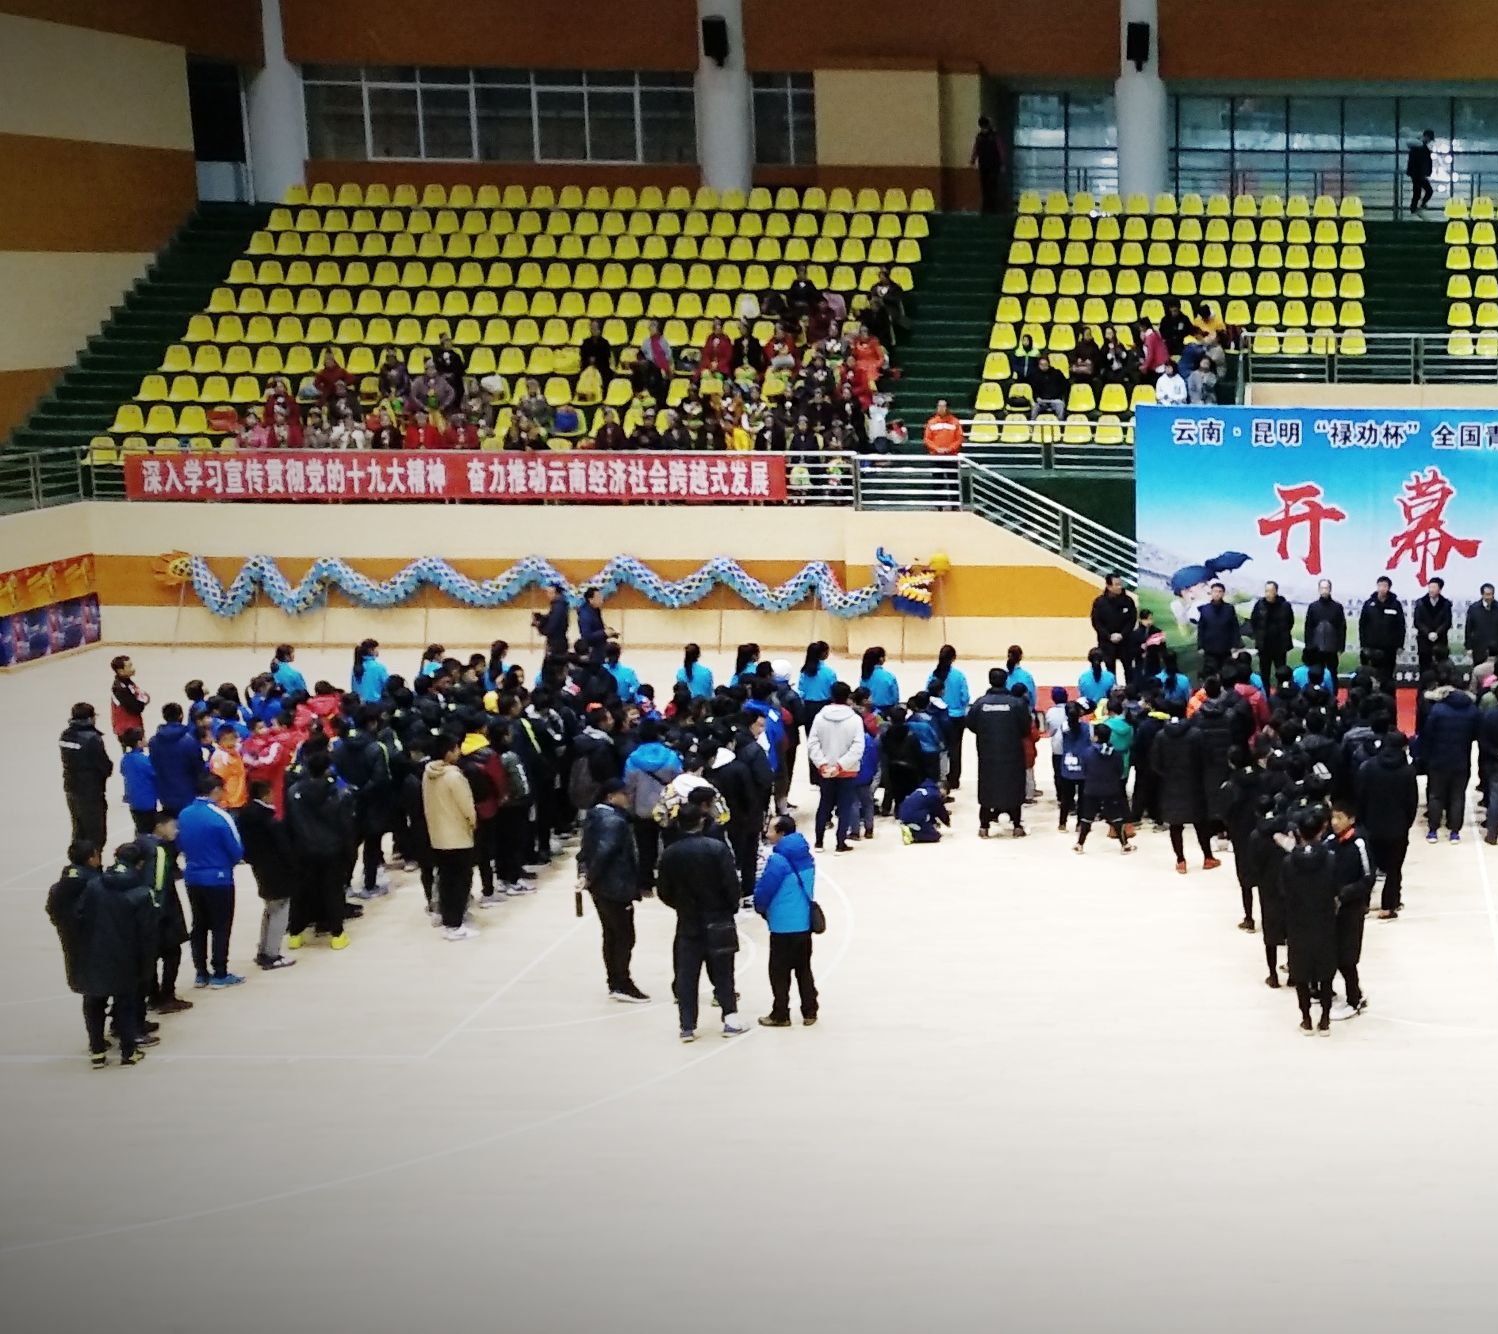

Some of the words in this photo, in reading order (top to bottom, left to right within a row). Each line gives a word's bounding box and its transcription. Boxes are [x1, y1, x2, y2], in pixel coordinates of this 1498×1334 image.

[142, 458, 446, 495] 深入学习宣传贯彻党的十九大精神
[466, 457, 769, 496] 奋力推动云南经济社会跨越式发展
